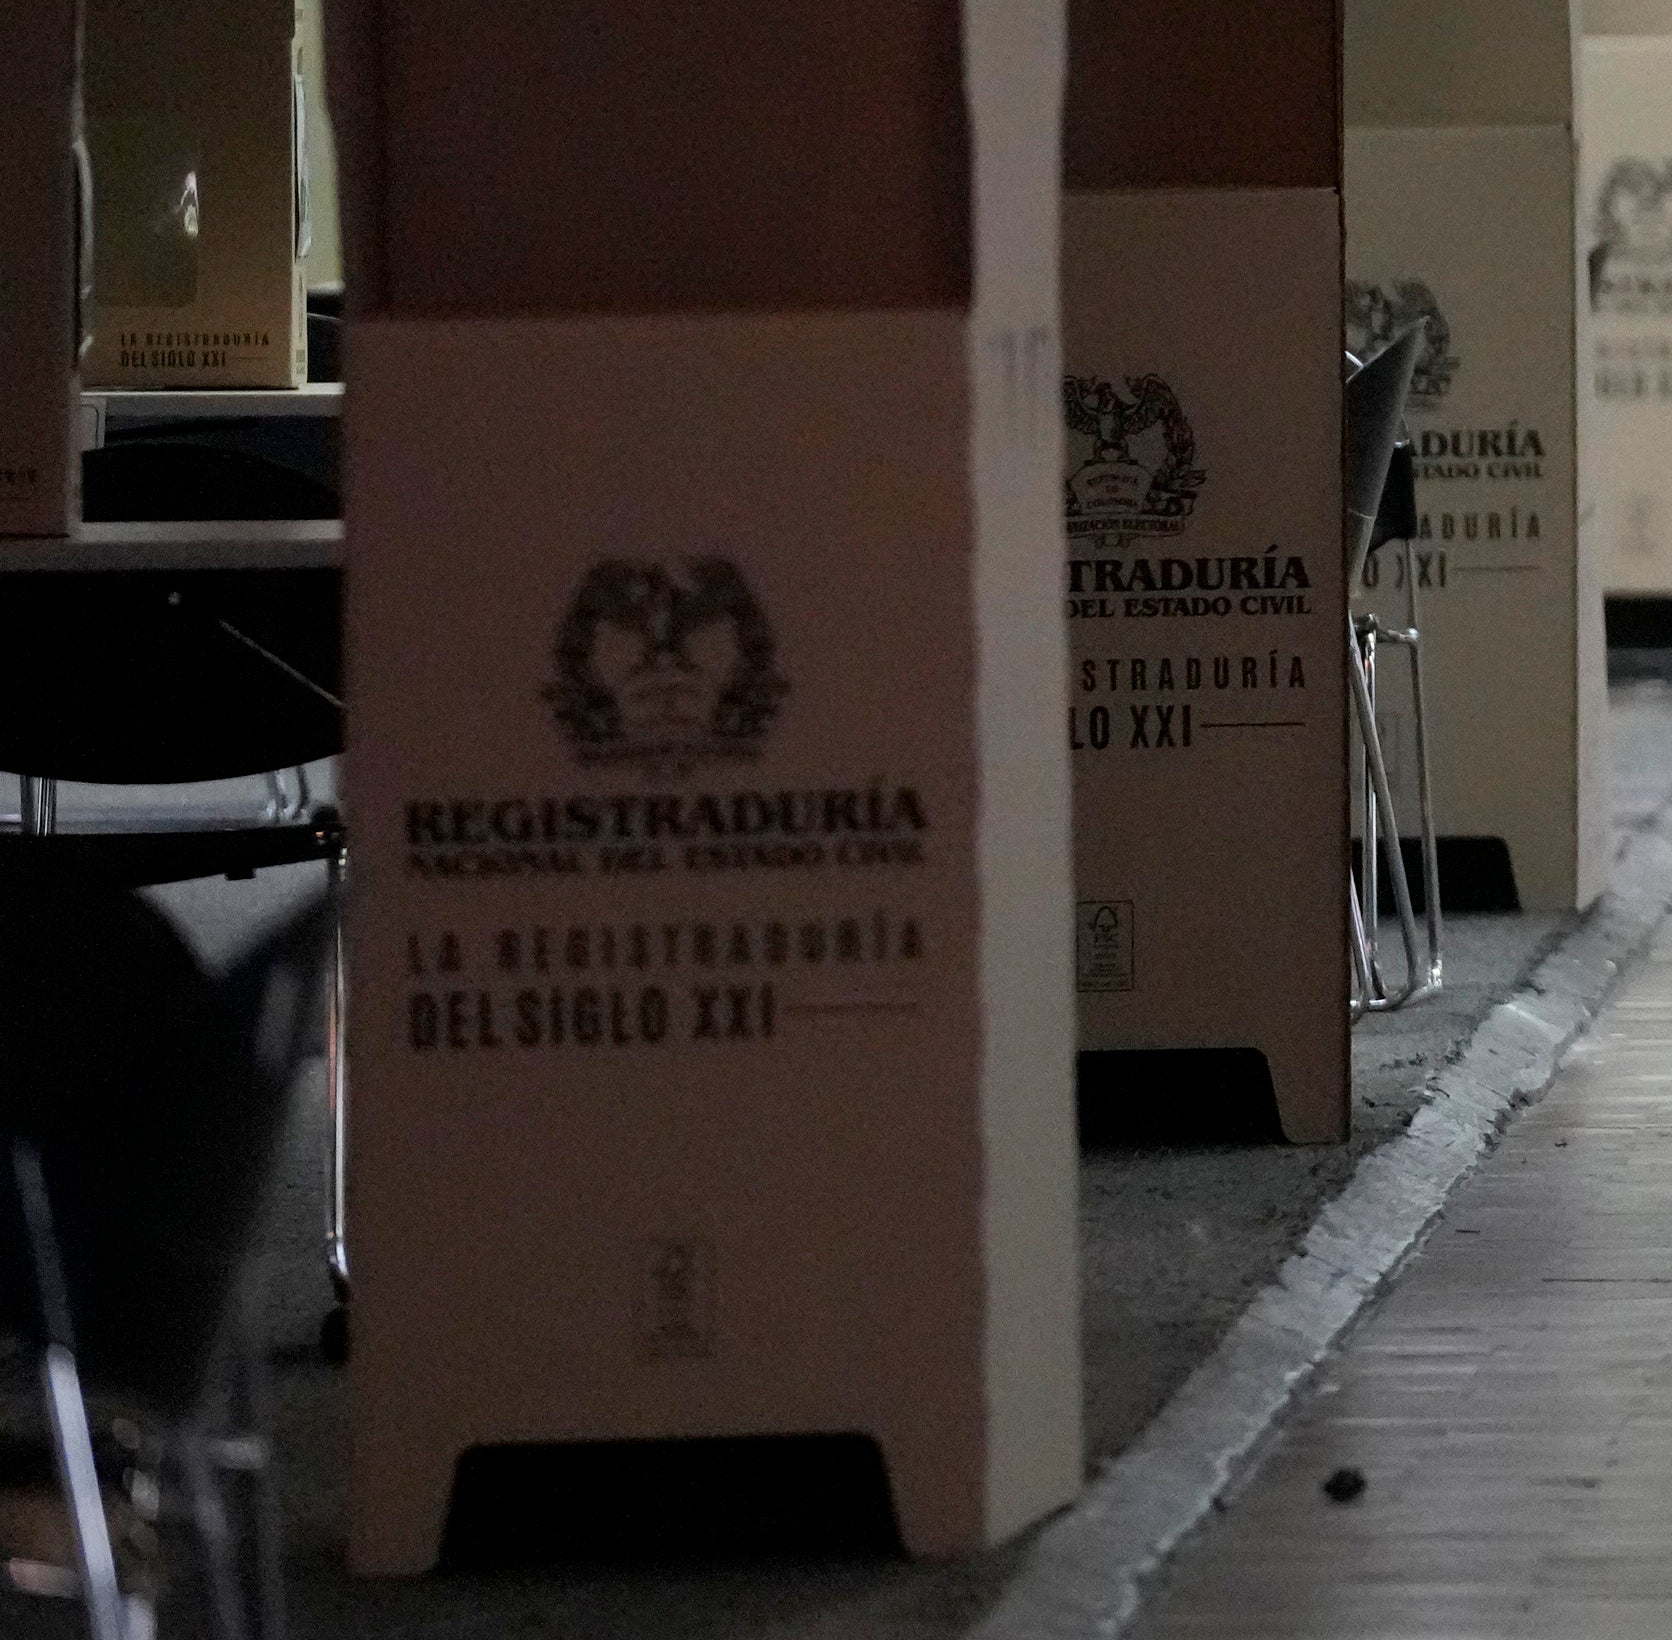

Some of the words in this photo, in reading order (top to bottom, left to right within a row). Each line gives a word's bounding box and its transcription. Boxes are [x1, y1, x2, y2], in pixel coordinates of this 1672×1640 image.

[121, 350, 147, 368] DEL
[202, 350, 226, 368] XXI
[1123, 595, 1233, 618] ESTADO
[1239, 594, 1312, 616] CIVIL
[1081, 647, 1307, 692] STRADURÍA
[1128, 703, 1193, 750] XXI
[402, 774, 929, 846] REGISTRADURÍA
[407, 988, 502, 1052] DEL
[514, 985, 670, 1048] SIGLO
[693, 980, 776, 1042] XXI
